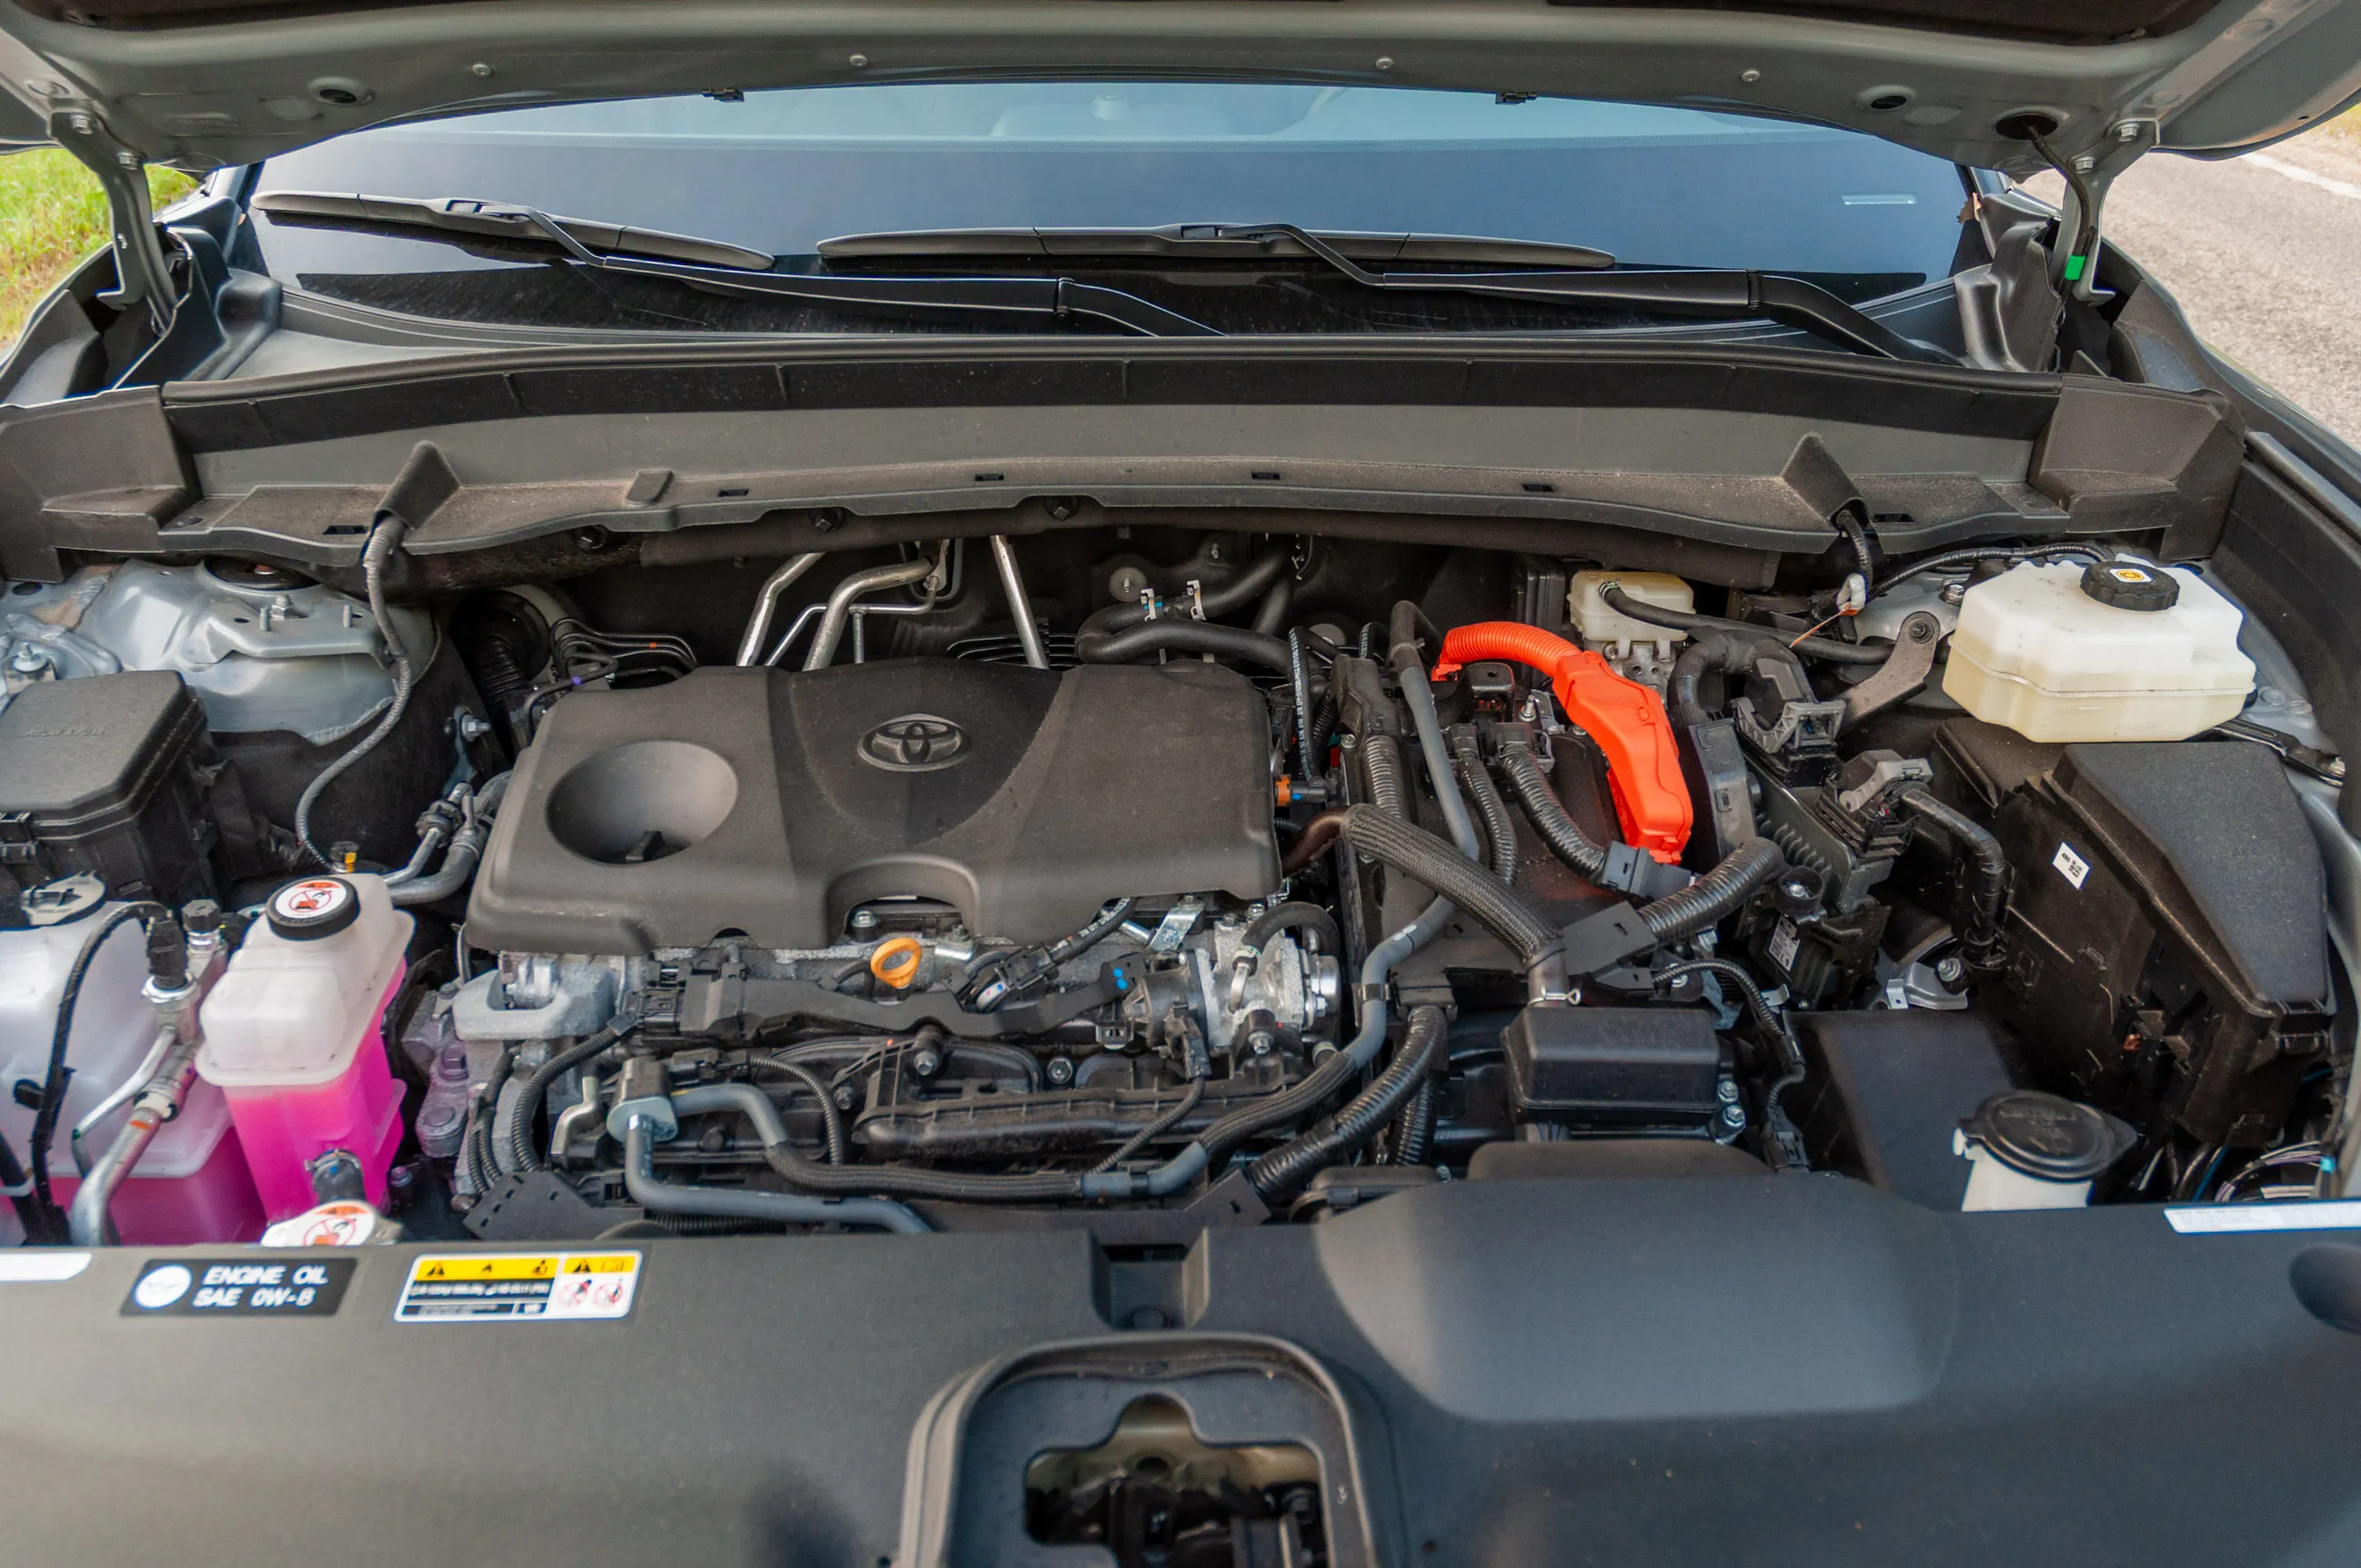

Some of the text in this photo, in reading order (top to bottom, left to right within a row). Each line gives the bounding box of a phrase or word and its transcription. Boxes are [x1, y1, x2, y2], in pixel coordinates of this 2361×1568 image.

[203, 1266, 329, 1286] ENGINE OIL
[193, 1287, 243, 1307] SAE
